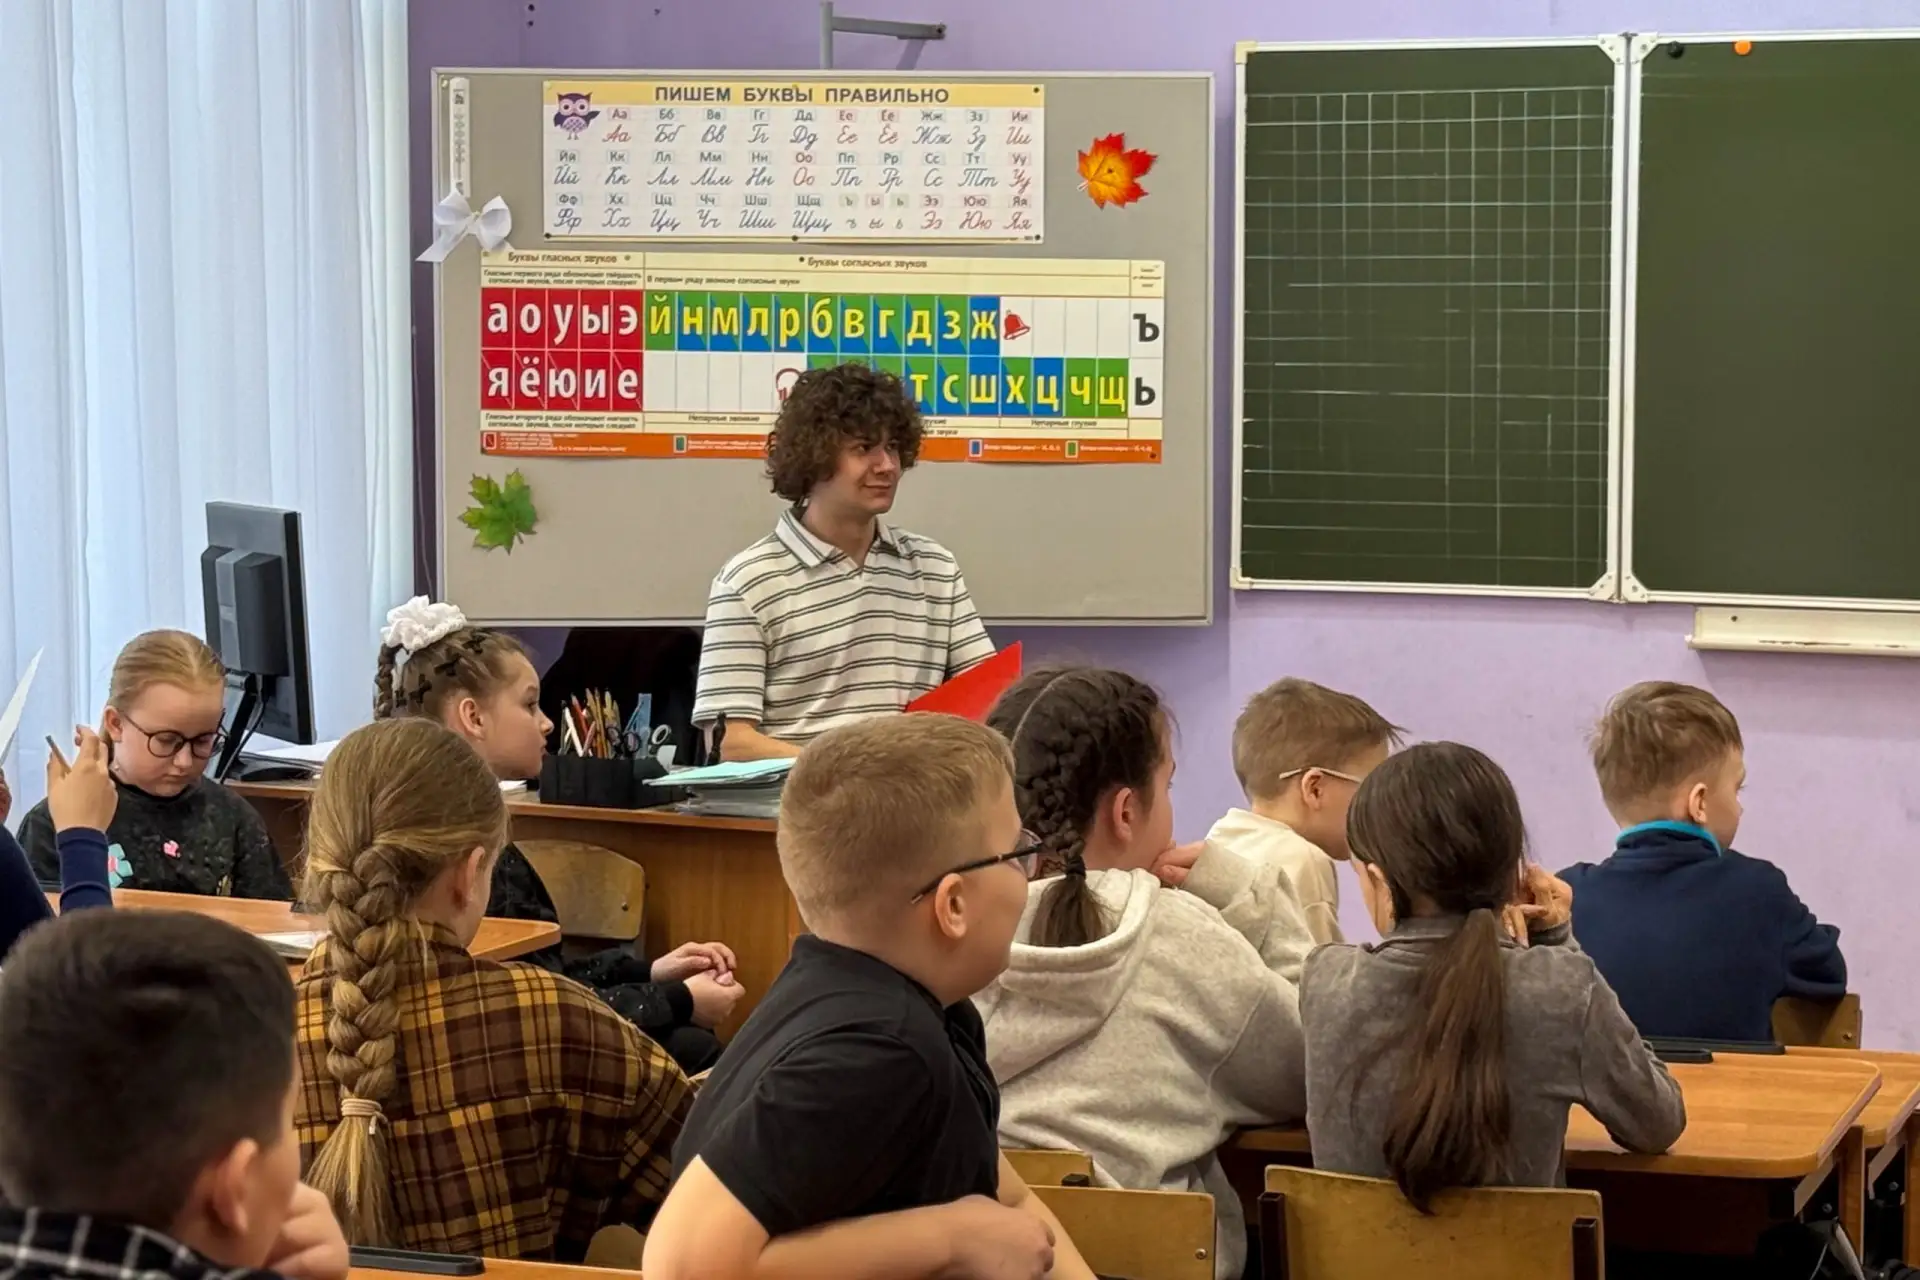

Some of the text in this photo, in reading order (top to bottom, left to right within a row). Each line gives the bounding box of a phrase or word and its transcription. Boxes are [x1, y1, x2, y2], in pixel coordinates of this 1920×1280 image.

[655, 87, 948, 102] ПИШЕМ БУКВЫ ПРАВИЛЬНО
[612, 109, 1028, 121] Аа Бб Вв Гг Дд Ее Ёё Жж Зз Ии
[560, 151, 1027, 165] Йй Кк Лл Мм Нн Оо Пп Рр Сс Тт Уу
[559, 194, 578, 205] Фф
[609, 194, 624, 204] Хх
[655, 195, 672, 206] Цц
[700, 195, 715, 204] Чч
[745, 196, 767, 205] Шш
[798, 196, 820, 207] Щщ
[925, 196, 938, 205] Ээ
[964, 196, 986, 206] Юю
[1013, 196, 1027, 206] Яя
[508, 252, 617, 264] Буквы гласных звуков
[808, 257, 927, 269] Буквы согласных звуков
